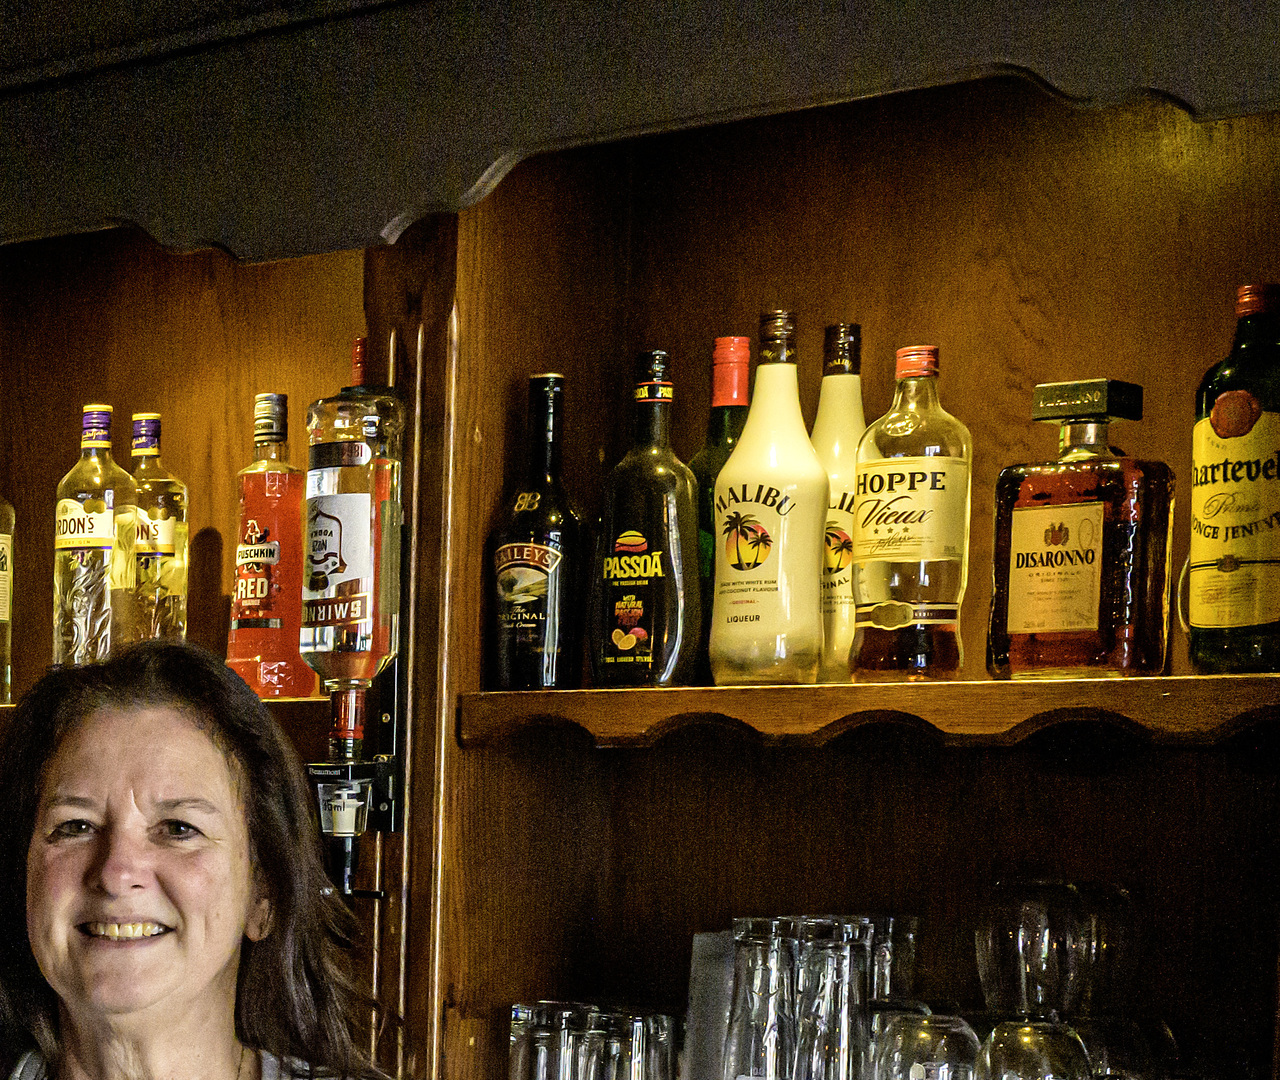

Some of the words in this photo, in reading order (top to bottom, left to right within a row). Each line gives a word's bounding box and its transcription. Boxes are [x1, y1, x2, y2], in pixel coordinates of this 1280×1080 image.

[857, 471, 946, 495] HOPPE
[857, 496, 934, 529] Vieux
[55, 515, 95, 534] RDON'S
[1015, 549, 1095, 569] DISARONNO
[238, 578, 268, 599] RED
[727, 614, 760, 623] LIQUEUR
